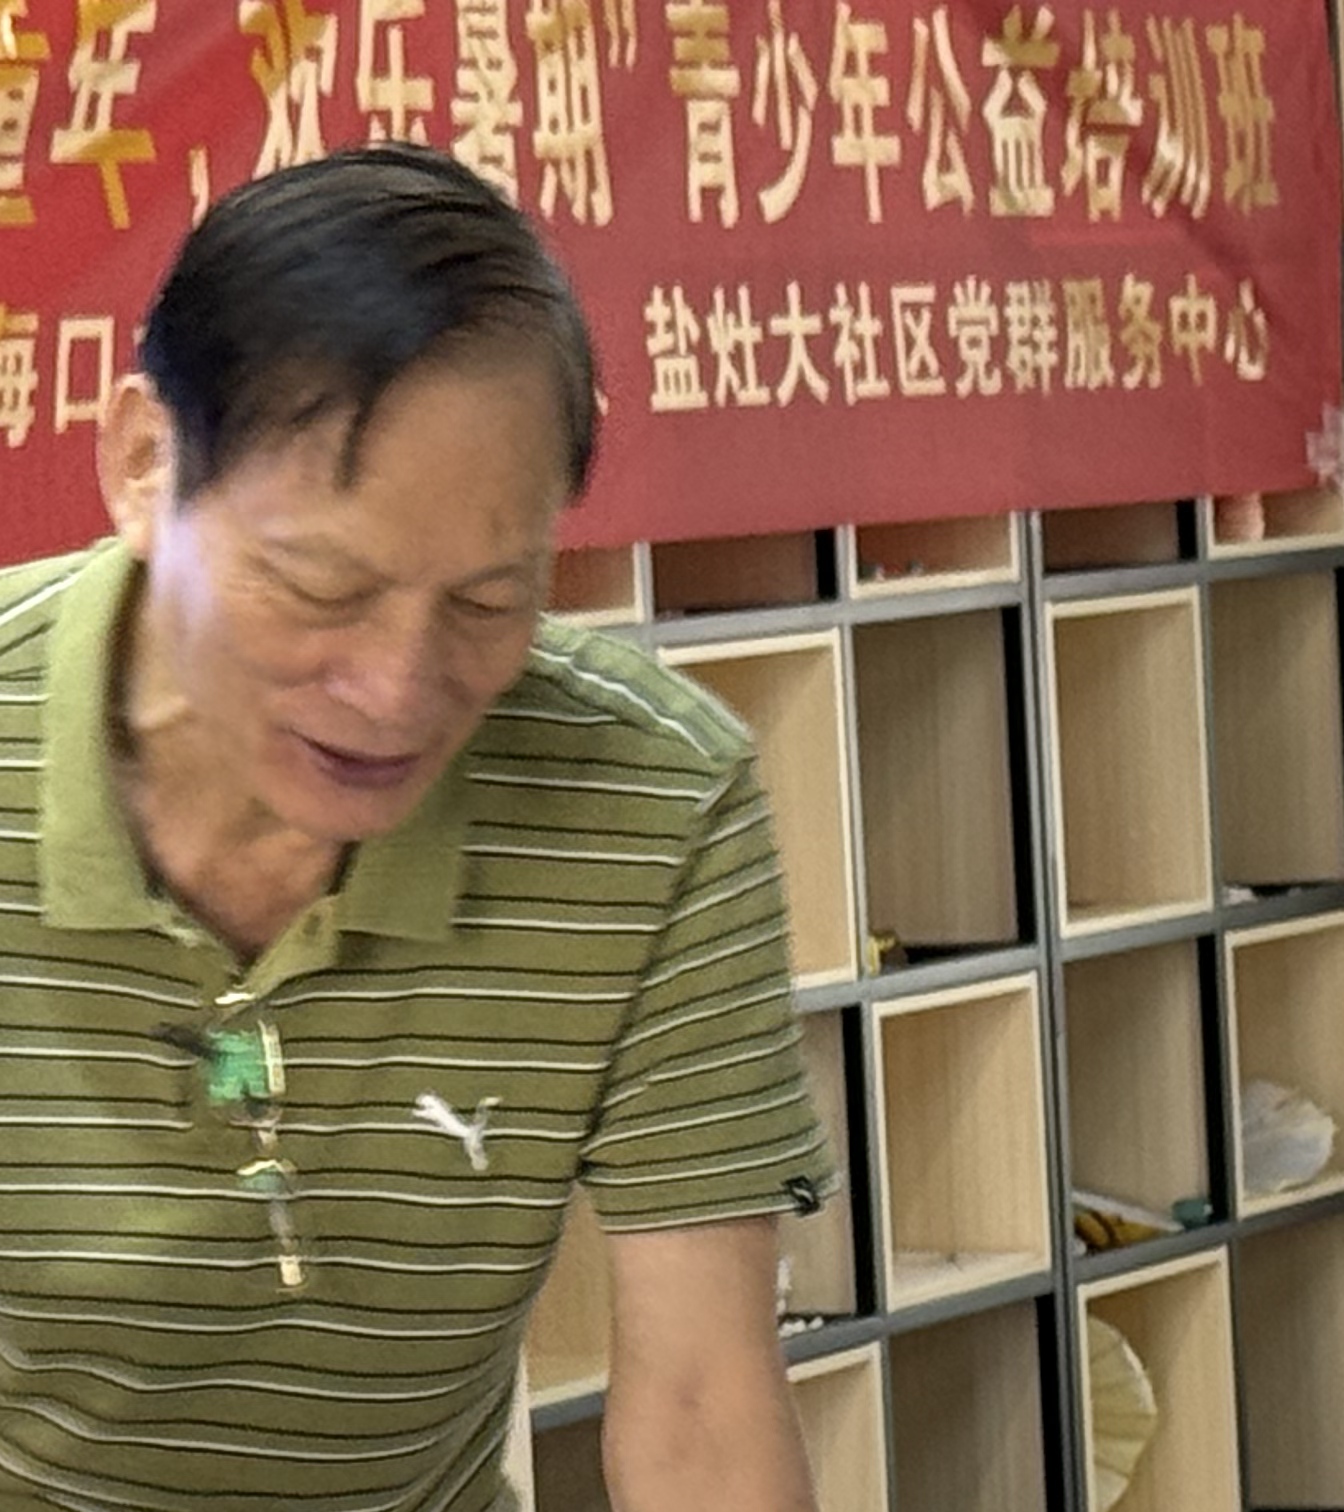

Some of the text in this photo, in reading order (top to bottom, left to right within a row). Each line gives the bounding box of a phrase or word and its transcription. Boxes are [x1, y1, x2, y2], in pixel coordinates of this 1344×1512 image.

[645, 273, 1269, 411] 盐灶大社区党群服务中心
